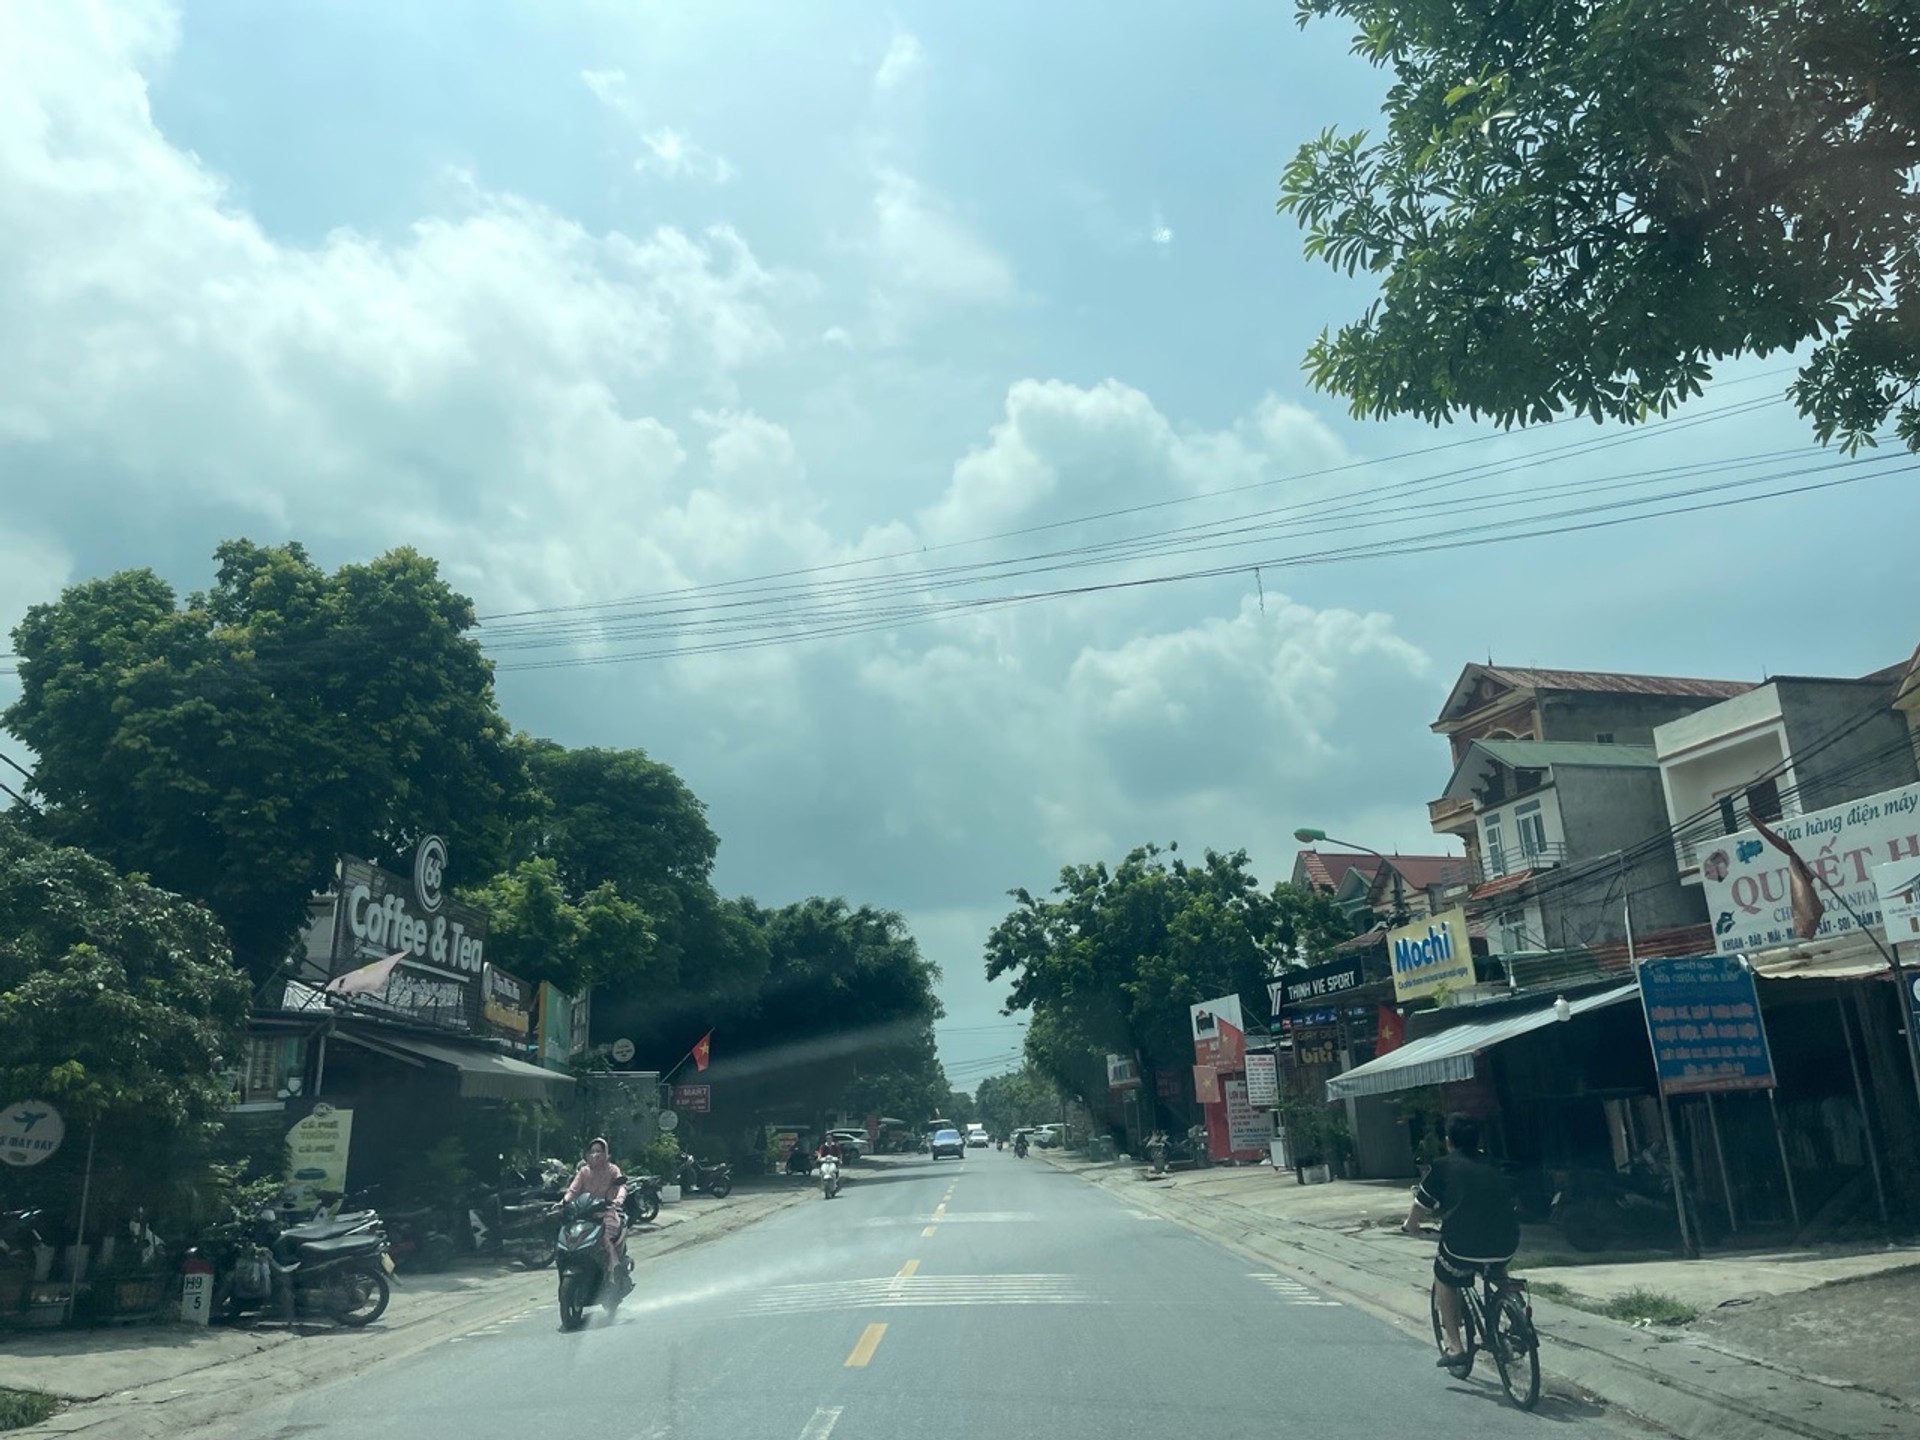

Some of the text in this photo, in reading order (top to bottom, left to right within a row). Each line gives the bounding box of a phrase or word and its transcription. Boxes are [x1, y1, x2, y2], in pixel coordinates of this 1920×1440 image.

[1846, 803, 1880, 826] điện
[1884, 792, 1918, 814] máy
[1731, 836, 1873, 914] QUẾT
[350, 885, 427, 957] Coffee
[452, 922, 483, 973] Tea
[1395, 921, 1450, 973] Mochi
[1327, 971, 1355, 992] SPORT
